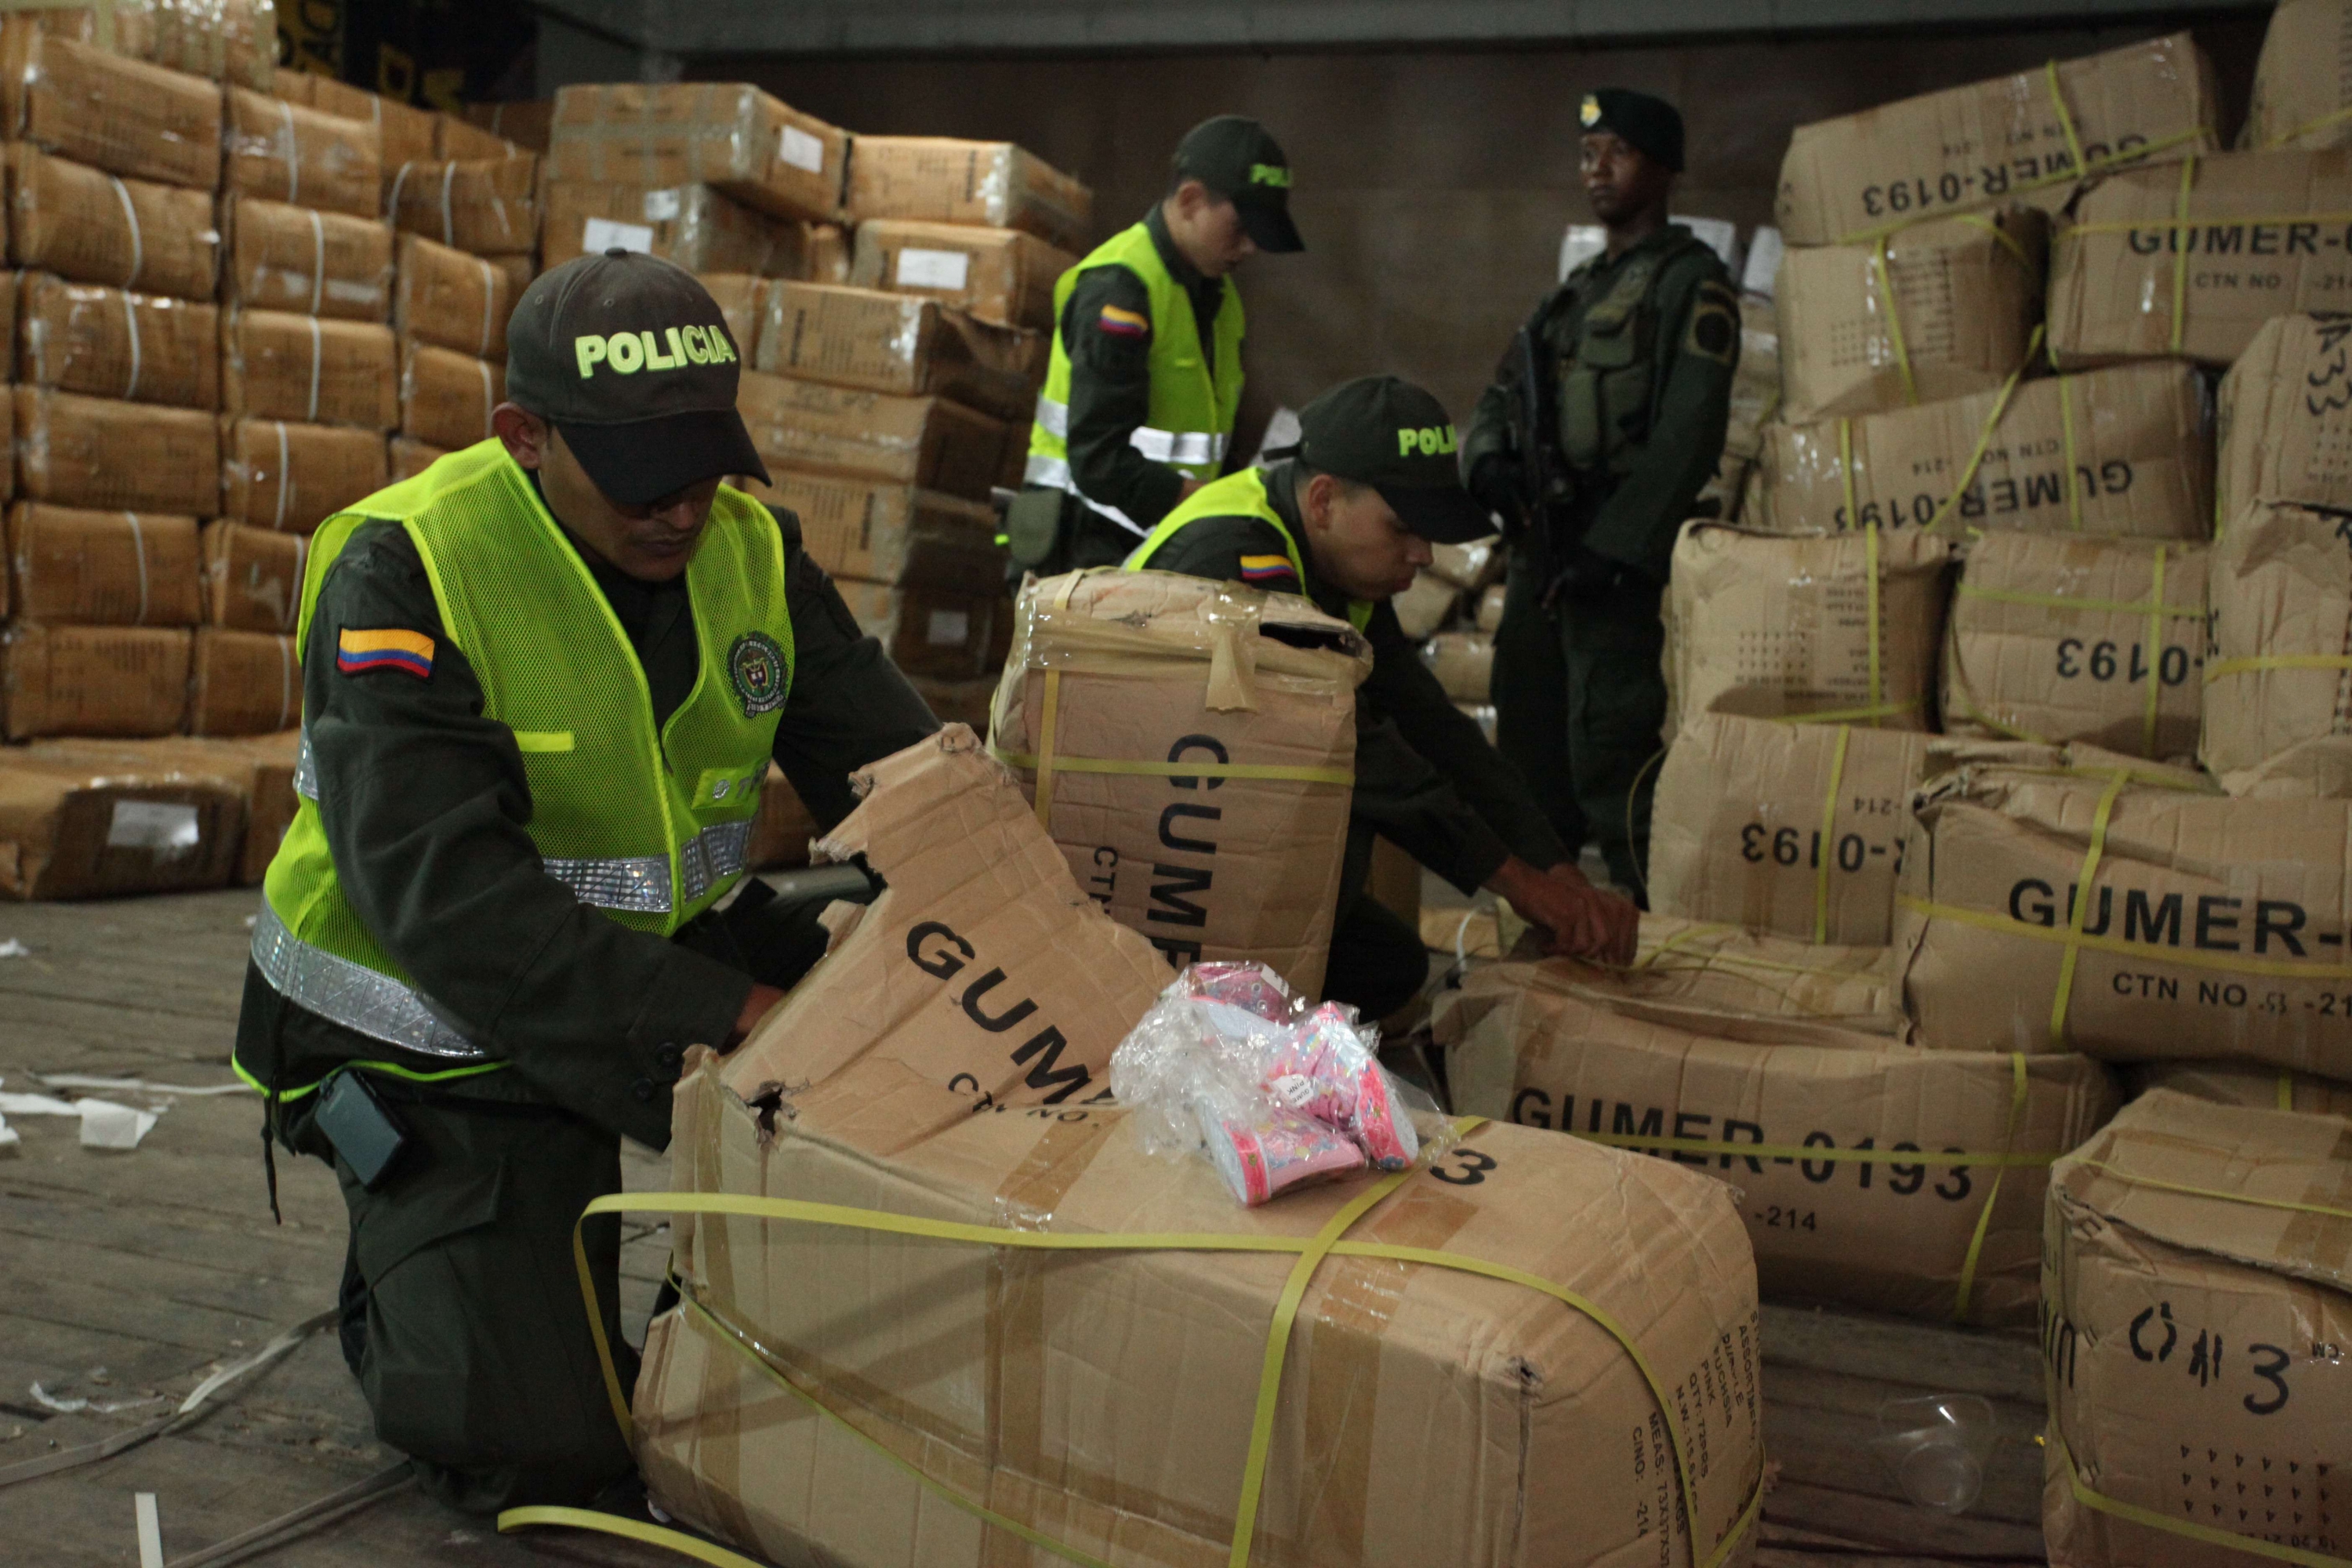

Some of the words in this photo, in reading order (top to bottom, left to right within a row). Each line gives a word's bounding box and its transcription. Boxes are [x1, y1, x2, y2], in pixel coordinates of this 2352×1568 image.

[2129, 223, 2352, 256] GUMER-
[575, 325, 738, 379] POLICIA
[2009, 878, 2352, 959] GUMER-
[2112, 972, 2180, 1000] CTN
[1754, 1207, 1817, 1233] -214
[1700, 1359, 1717, 1406] PINK
